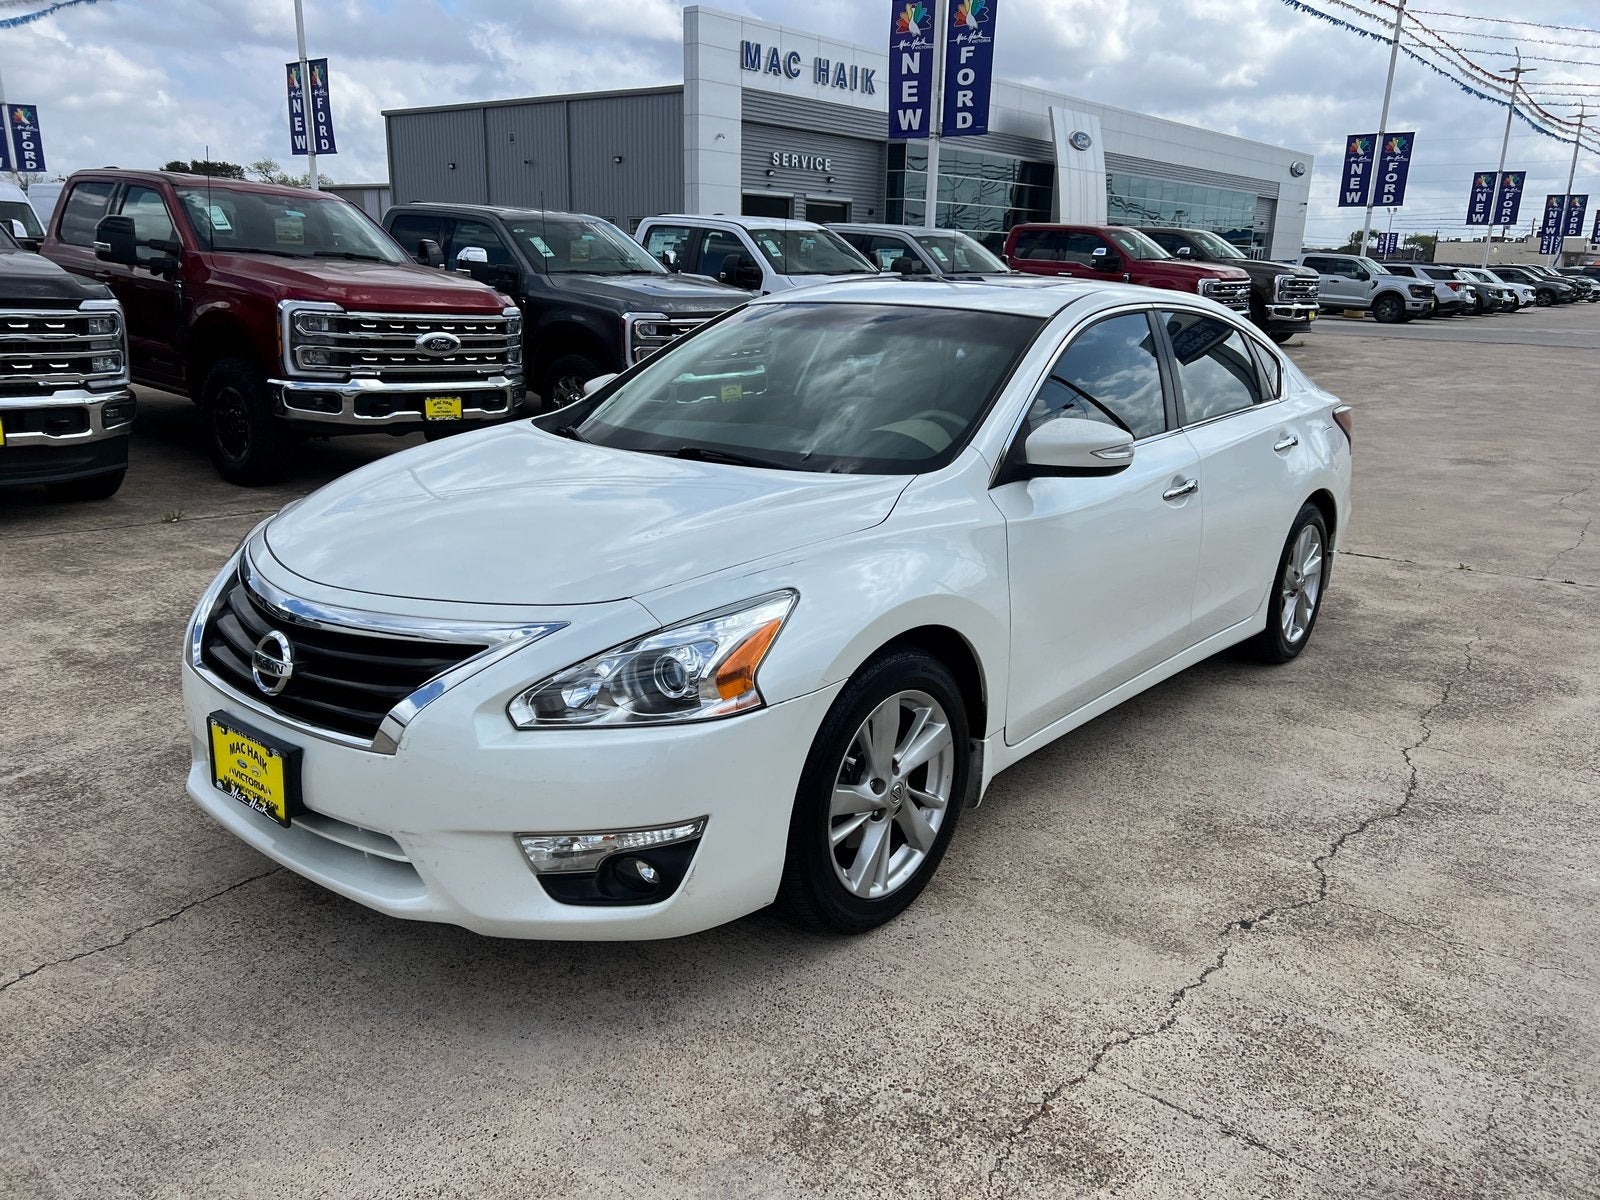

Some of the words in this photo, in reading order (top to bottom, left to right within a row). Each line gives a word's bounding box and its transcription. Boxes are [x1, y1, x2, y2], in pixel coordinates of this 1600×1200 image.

[741, 40, 801, 79] MAC
[814, 57, 876, 95] HAIK
[897, 51, 922, 131] NEW
[956, 46, 975, 129] FORD
[292, 99, 306, 150] NEW
[317, 98, 329, 150] FORD
[22, 131, 37, 169] FORD
[772, 152, 832, 171] SERVICE
[1345, 163, 1363, 204] NEW
[1382, 162, 1399, 204] FORD
[1472, 192, 1487, 223] NEW
[1501, 192, 1514, 223] FORD
[1545, 210, 1558, 234] NEW
[1568, 210, 1579, 234] FORD
[1541, 240, 1549, 253] NEW
[430, 339, 451, 350] Ford
[229, 741, 246, 756] MAC
[246, 745, 268, 775] HAIK
[229, 786, 247, 802] Mac
[235, 768, 265, 793] VICTORIA
